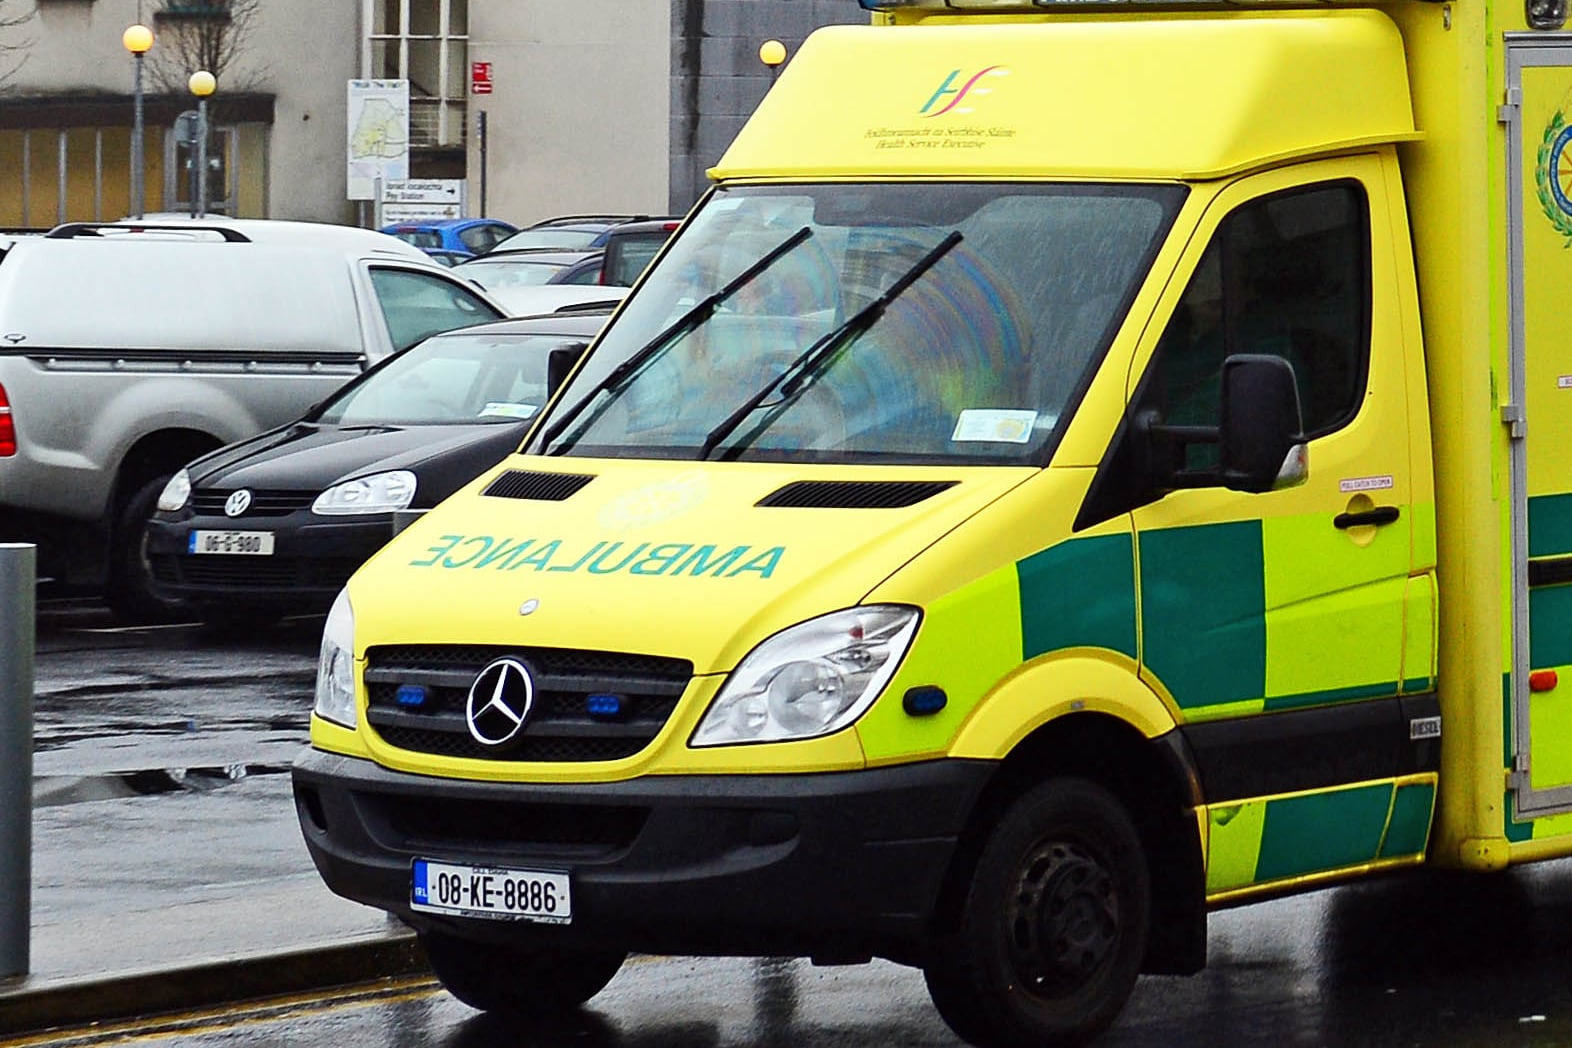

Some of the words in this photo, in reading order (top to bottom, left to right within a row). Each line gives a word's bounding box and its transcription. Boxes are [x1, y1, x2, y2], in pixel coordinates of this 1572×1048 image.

[1411, 719, 1439, 737] DIESEL
[415, 888, 428, 898] IRL
[437, 872, 557, 913] 08-KE-8886
